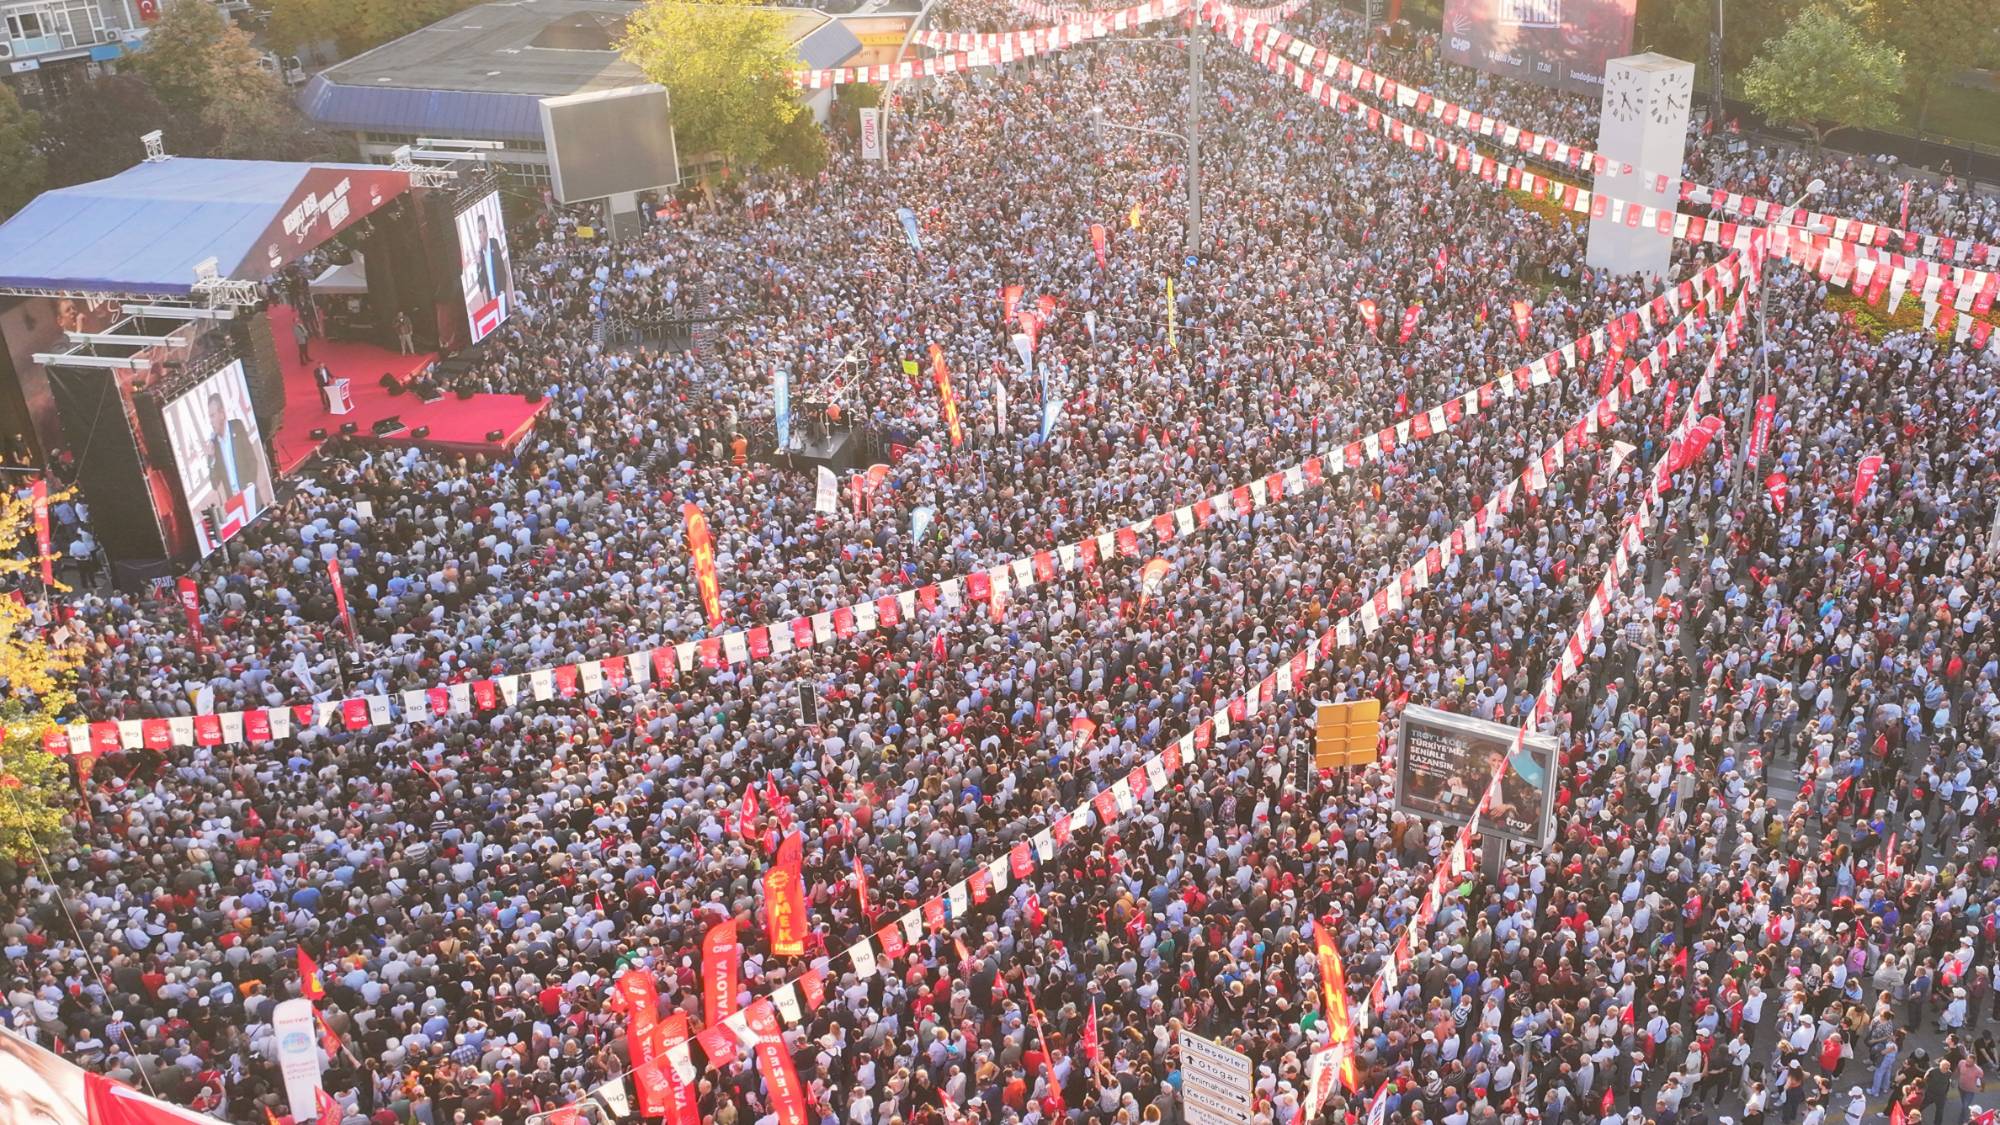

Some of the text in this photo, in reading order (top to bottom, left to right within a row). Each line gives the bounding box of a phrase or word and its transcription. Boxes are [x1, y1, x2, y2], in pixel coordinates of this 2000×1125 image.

[1451, 37, 1471, 51] CHP
[1410, 746, 1446, 761] SENİNLE
[1409, 754, 1456, 771] KAZANSIN.
[1506, 816, 1532, 832] troy
[775, 891, 793, 941] EMEK
[713, 944, 733, 953] CHP
[716, 960, 729, 1019] YALOVA
[663, 1036, 685, 1047] CHP
[1198, 1060, 1238, 1083] Otogar
[1187, 1072, 1234, 1097] Yenimahalle
